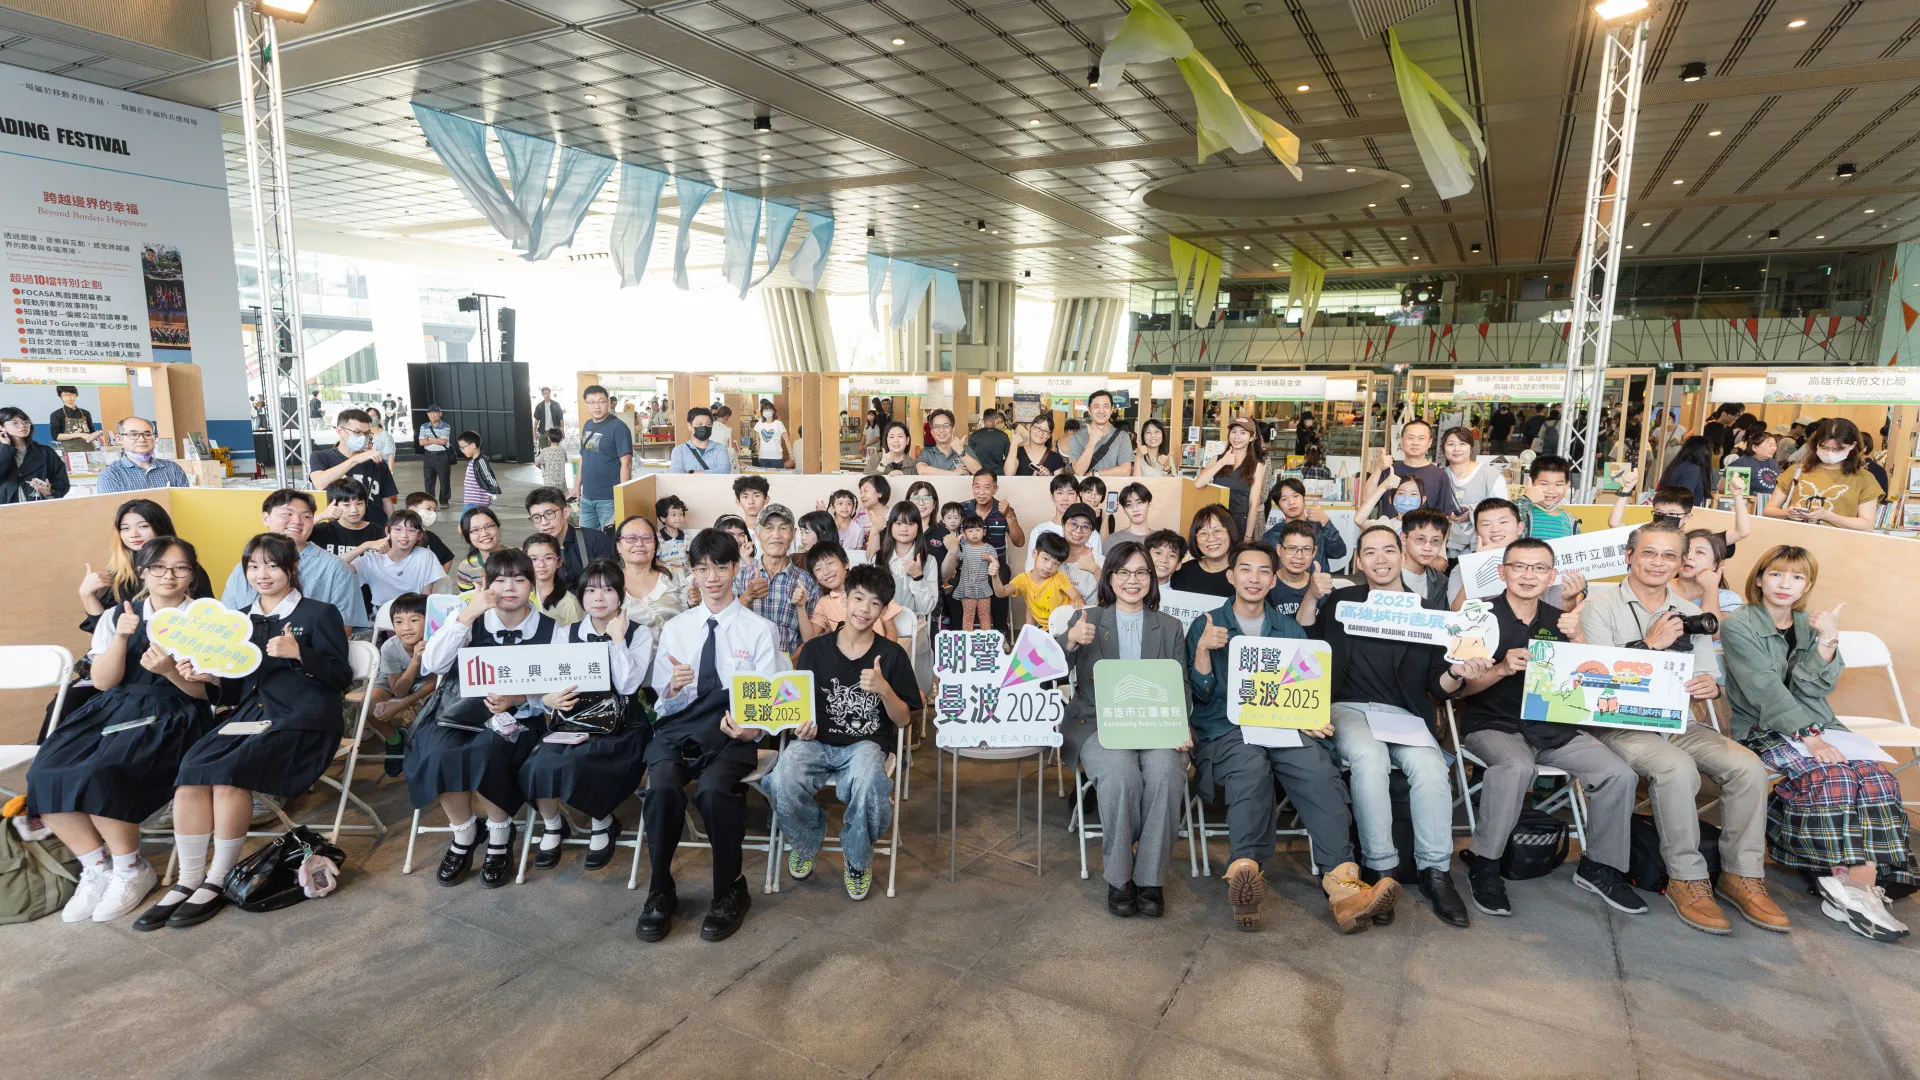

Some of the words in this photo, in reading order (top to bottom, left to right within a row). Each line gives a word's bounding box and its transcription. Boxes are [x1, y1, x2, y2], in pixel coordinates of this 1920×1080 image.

[56, 127, 131, 156] FESTIVAL
[43, 191, 139, 215] 跨越邊界的幸福
[37, 206, 71, 218] Beyond
[73, 211, 105, 222] Borders
[106, 215, 148, 228] Happiness
[9, 273, 103, 290] 超過10檔特別企劃
[25, 318, 47, 326] Build
[1233, 378, 1302, 387] 客家公共傳播基金會
[1808, 376, 1906, 387] 高雄市政府文化局
[1554, 543, 1627, 567] 雄市立圖書
[1556, 565, 1590, 576] ohsiung
[1592, 560, 1616, 571] Public
[1373, 593, 1415, 609] 2025
[1162, 605, 1204, 619] 高雄市立
[1340, 605, 1446, 630] 高雄城市書展
[1348, 624, 1380, 634] KAOHSIUNG
[1381, 628, 1405, 637] READING
[1407, 630, 1433, 640] FESTIVAL
[937, 633, 1000, 674] 朗聲
[1238, 646, 1282, 674] 朗聲
[498, 662, 601, 678] 銓興營造
[743, 681, 772, 699] 朗聲
[1238, 679, 1280, 707] 曼波
[1283, 687, 1320, 709] 2025
[938, 683, 1001, 725] 曼波
[1006, 692, 1061, 722] 2025
[1102, 706, 1181, 718] 高雄市立圖書館
[744, 704, 773, 722] 曼波
[775, 708, 801, 721] 2025
[1103, 720, 1137, 728] Kaohsiung
[1159, 720, 1182, 728] Library
[940, 735, 981, 744] PLAY
